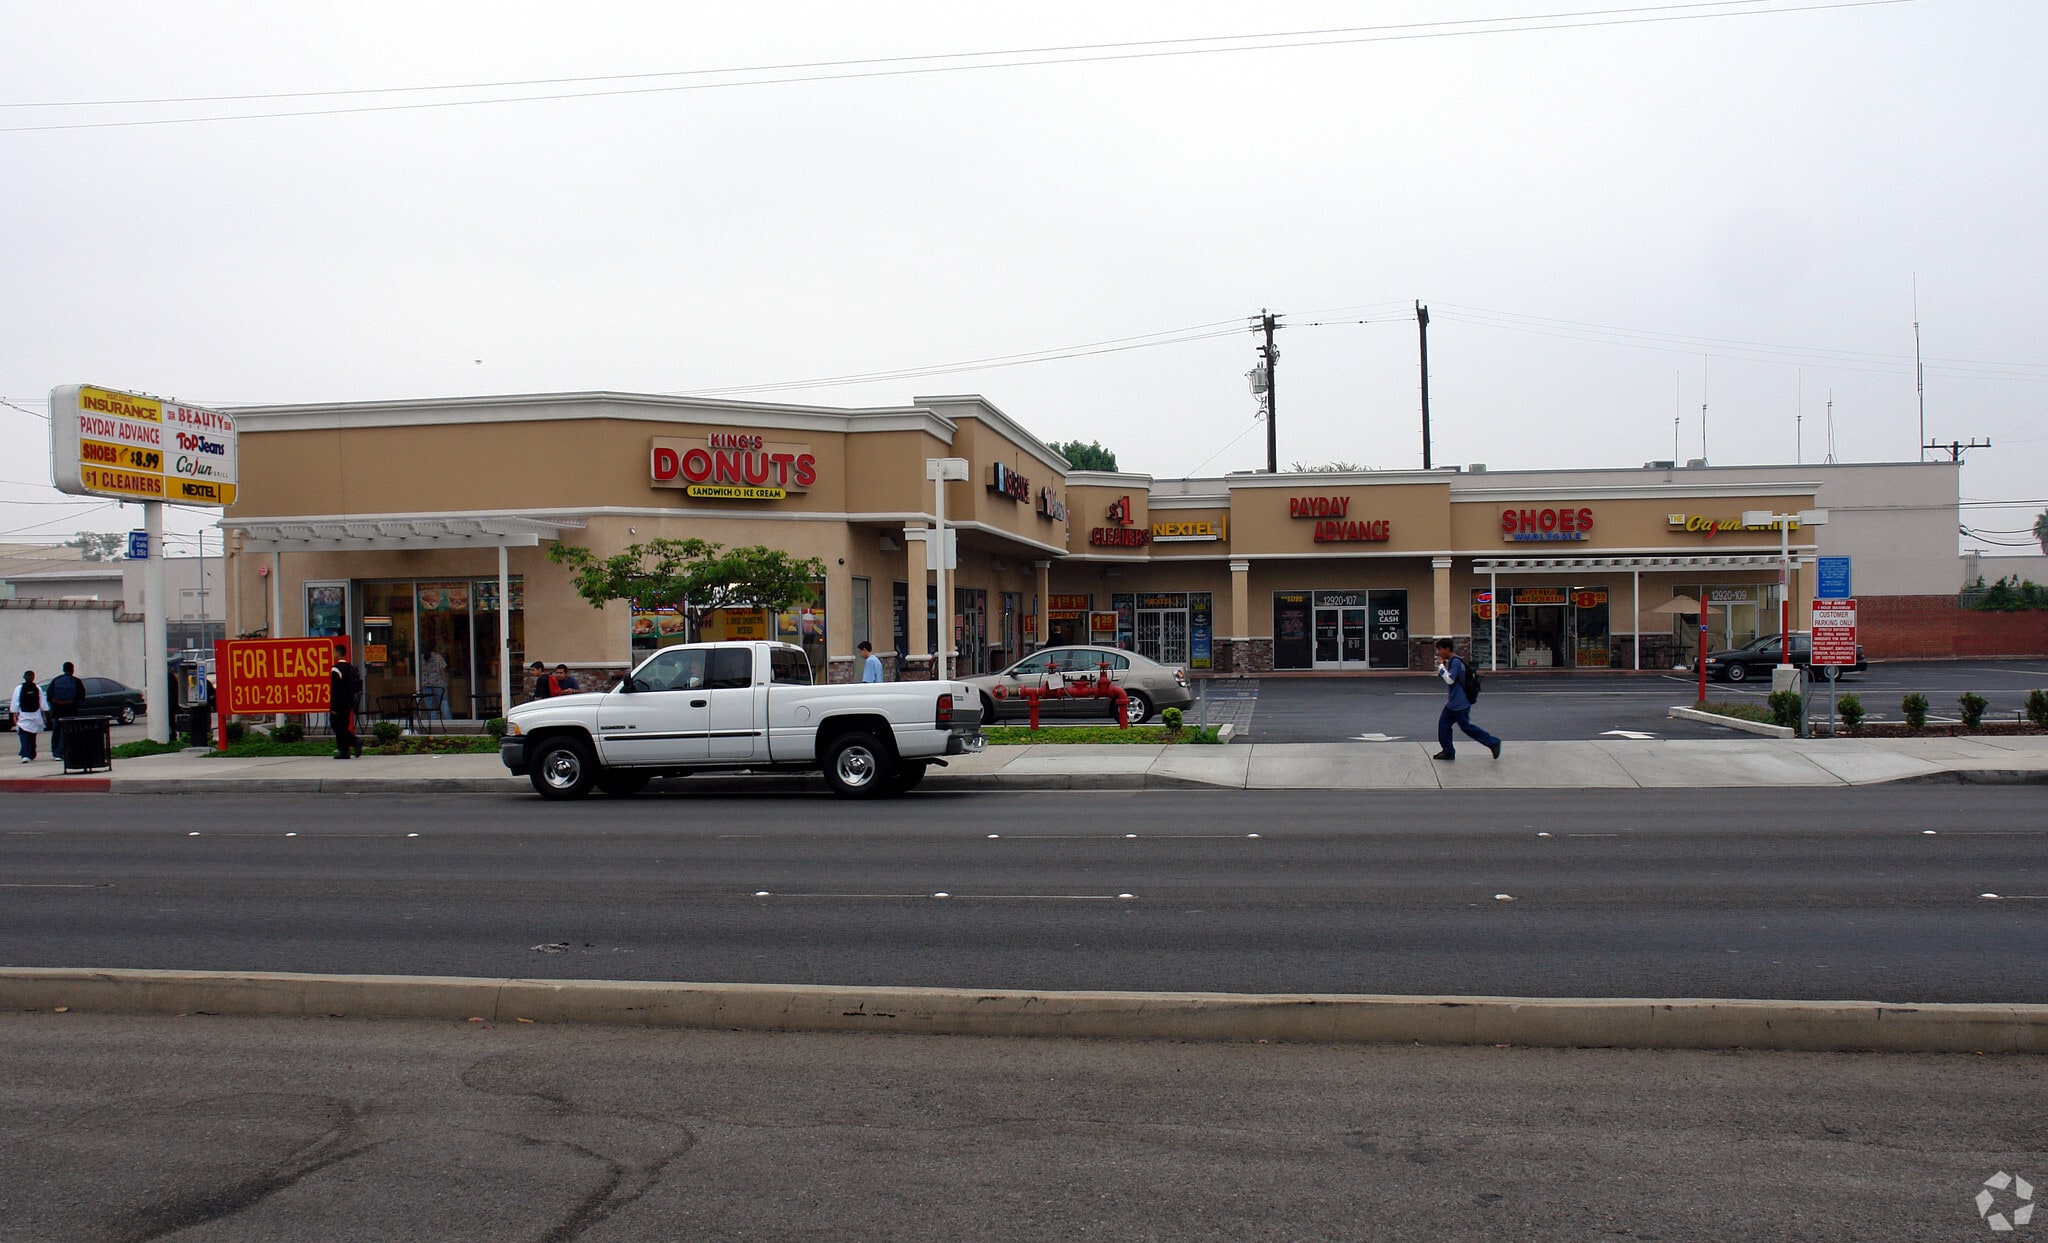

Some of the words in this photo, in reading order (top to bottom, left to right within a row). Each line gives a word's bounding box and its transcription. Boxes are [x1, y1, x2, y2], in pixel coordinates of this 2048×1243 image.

[84, 396, 157, 420] INSURANCE
[178, 407, 224, 429] BEAUTY
[80, 416, 115, 437] PAYDAY
[119, 422, 160, 444] ADVANCE
[709, 433, 763, 450] KING'S
[83, 442, 117, 463] SHOES
[130, 451, 159, 469] $8.99
[176, 455, 212, 476] Cajun
[653, 447, 817, 486] DONUTS
[86, 471, 97, 486] $1
[102, 472, 161, 493] CLEANERS
[182, 483, 217, 498] NEXTEL
[692, 487, 733, 497] SANDWICH
[743, 487, 753, 497] ICE
[756, 488, 781, 498] CREAM
[1109, 496, 1134, 525] $1
[1290, 496, 1350, 518] PAYDAY
[1152, 522, 1217, 536] NEXTEL
[1313, 520, 1390, 542] ADVANCE
[1502, 508, 1594, 532] SHOES
[1669, 514, 1684, 523] THE
[1685, 514, 1741, 539] Cajun
[1092, 527, 1150, 547] CLEANERS
[1513, 532, 1582, 541] WHOLESALE
[233, 649, 268, 679] FOR
[273, 647, 330, 678] LEASE
[234, 683, 331, 706] 310-281-8573
